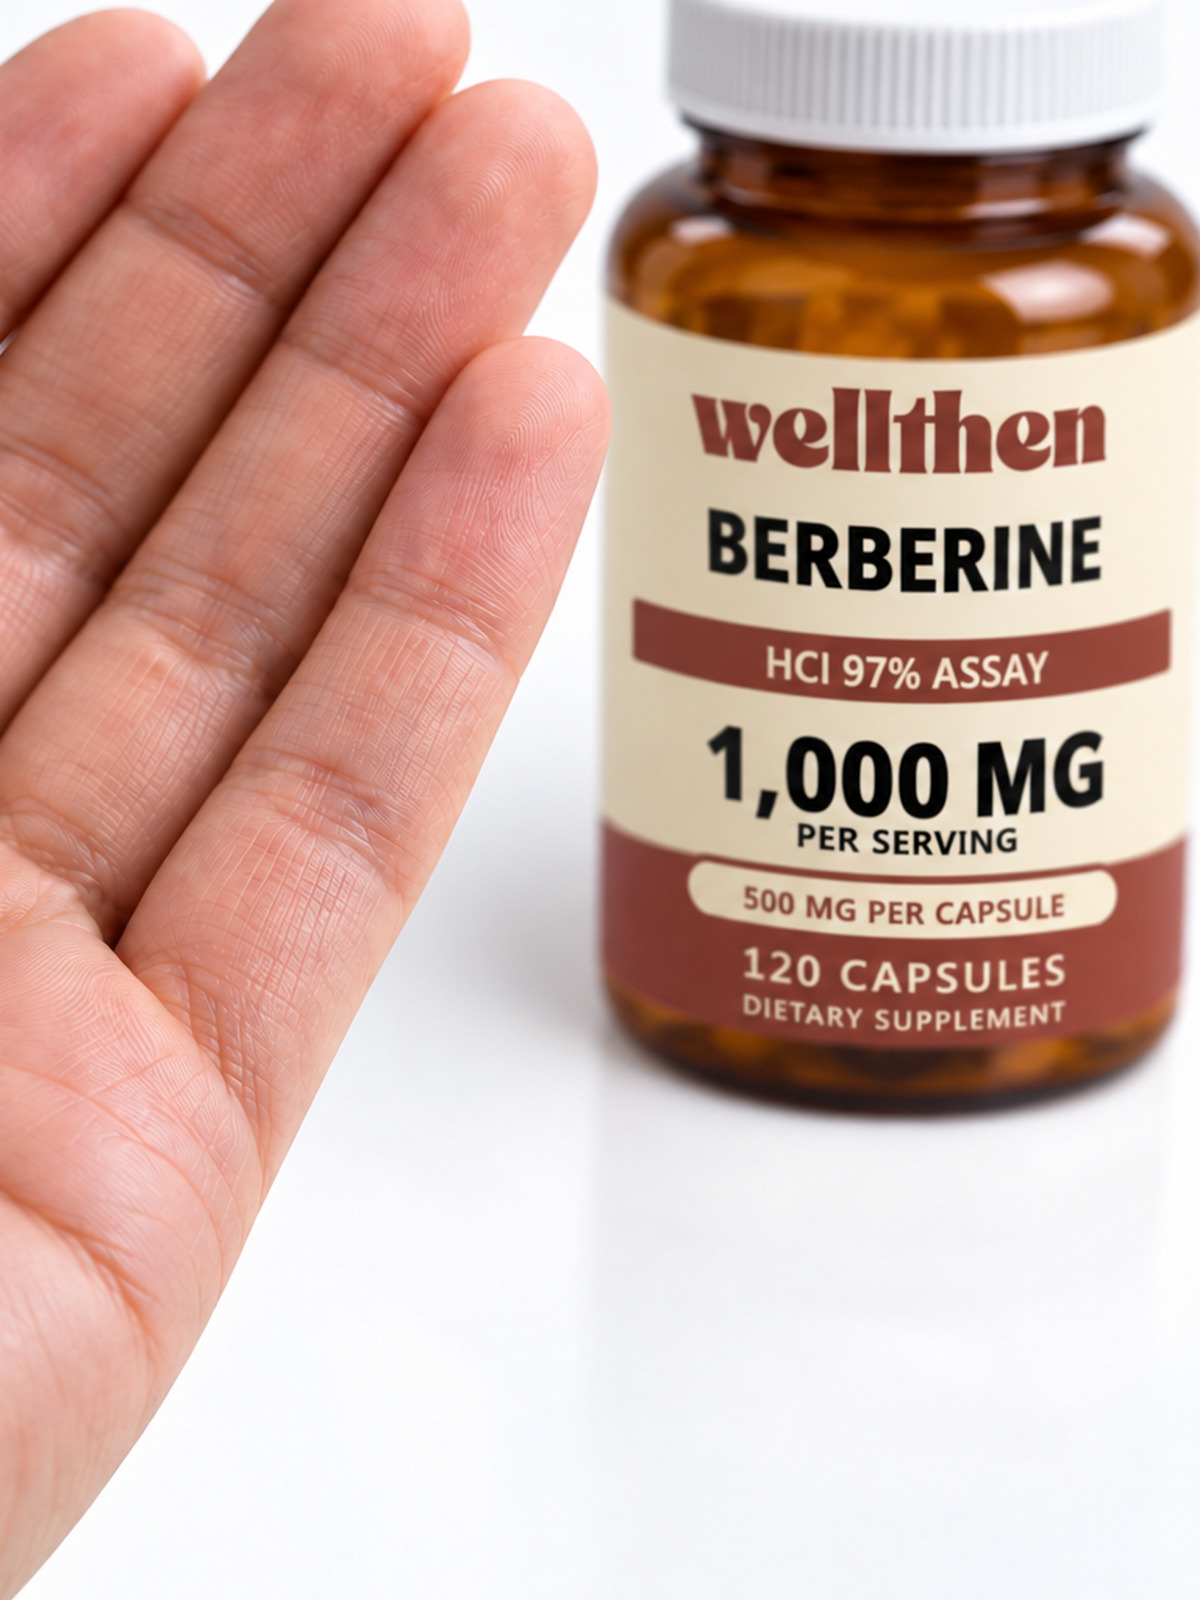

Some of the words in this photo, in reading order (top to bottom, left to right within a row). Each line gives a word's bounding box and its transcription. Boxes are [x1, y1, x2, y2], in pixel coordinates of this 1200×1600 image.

[691, 387, 1107, 475] wellthen
[708, 507, 1102, 593] BERBERINE
[842, 654, 921, 689] 97%
[932, 651, 1049, 690] ASSAY
[707, 725, 949, 820] 1,000
[976, 730, 1104, 817] MG
[796, 823, 859, 853] PER
[872, 828, 1018, 856] SERVING
[743, 886, 795, 916] 500
[806, 895, 856, 922] MG
[868, 900, 924, 925] PER
[935, 893, 1065, 926] CAPSULE
[743, 948, 821, 988] 120
[840, 954, 1066, 995] CAPSULES
[743, 994, 863, 1029] DIETARY
[875, 1000, 1066, 1032] SUPPLEMENT
